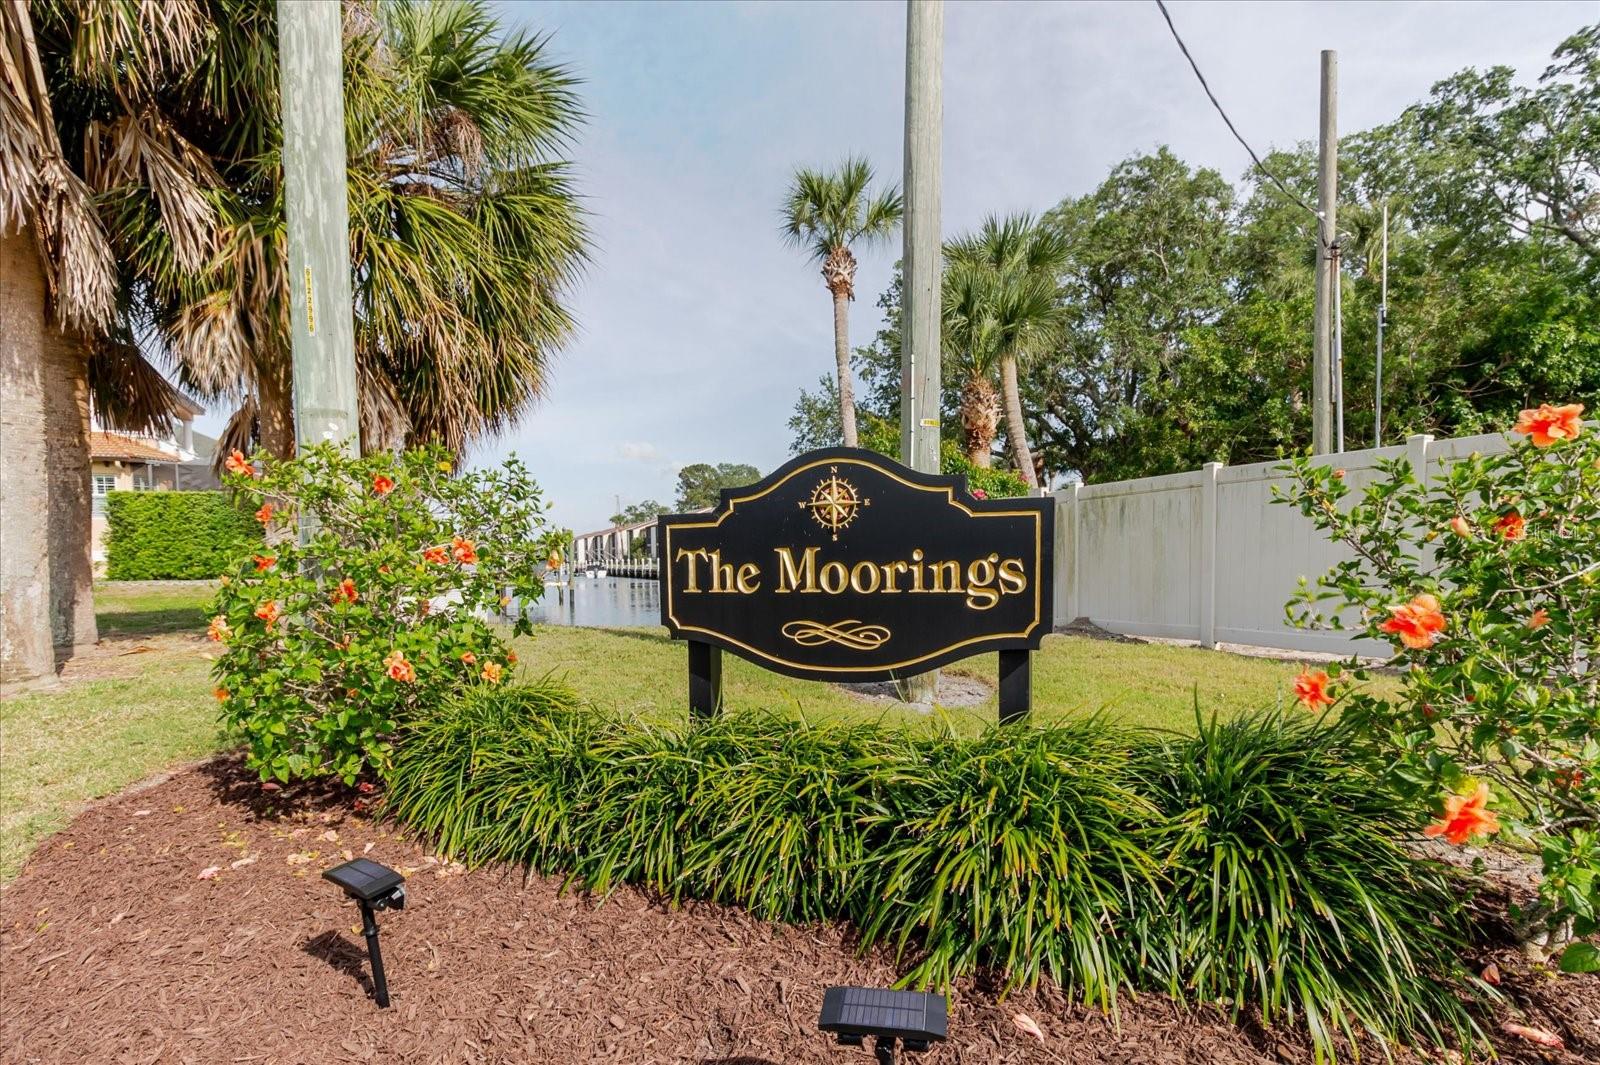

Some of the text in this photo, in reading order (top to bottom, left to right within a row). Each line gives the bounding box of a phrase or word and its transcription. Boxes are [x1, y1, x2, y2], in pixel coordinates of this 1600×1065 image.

[830, 465, 838, 474] N
[797, 501, 807, 509] W
[864, 498, 871, 506] E
[832, 534, 838, 542] S
[675, 547, 1027, 610] The Moorings
